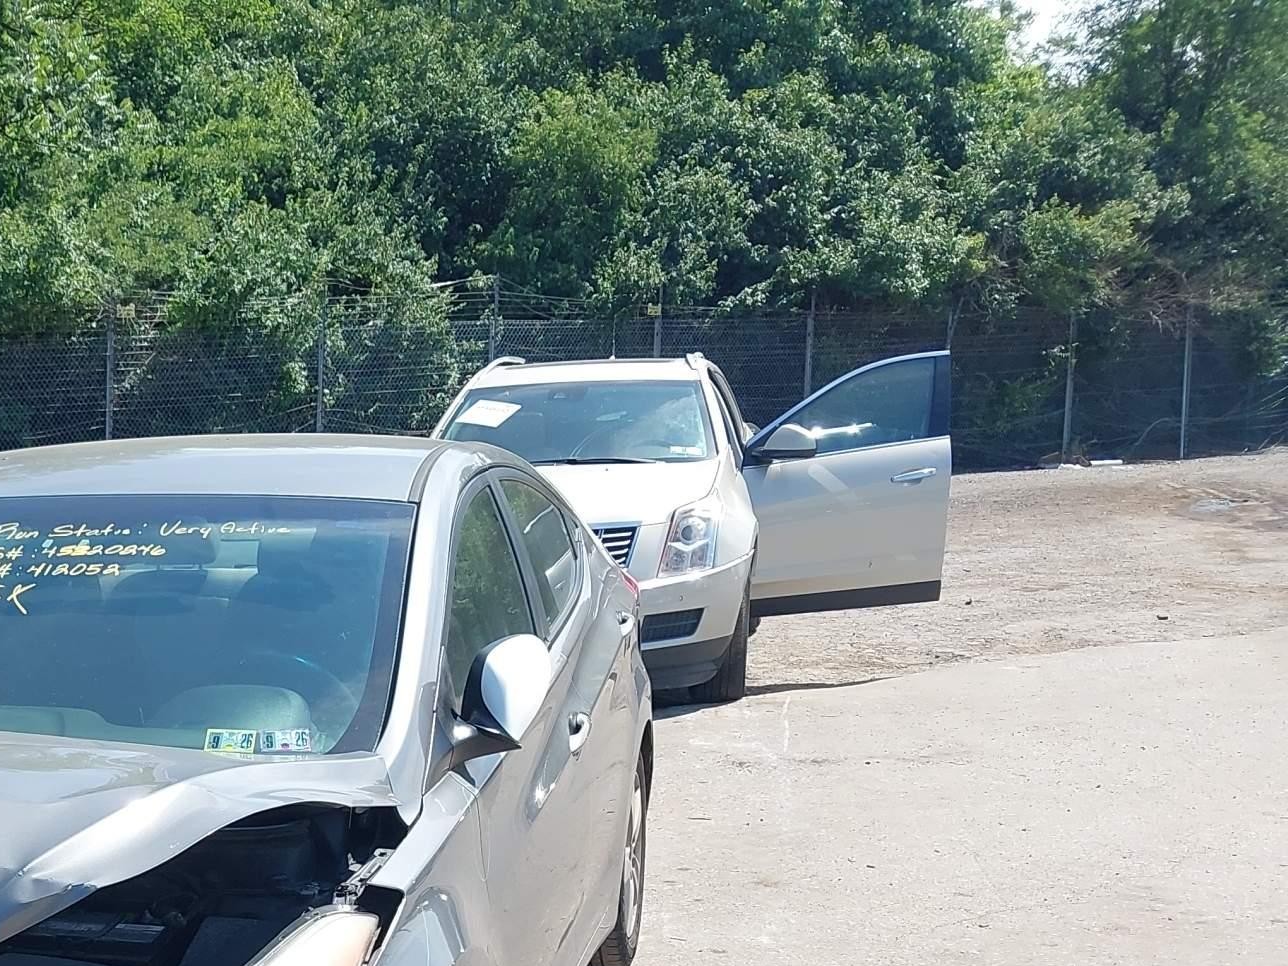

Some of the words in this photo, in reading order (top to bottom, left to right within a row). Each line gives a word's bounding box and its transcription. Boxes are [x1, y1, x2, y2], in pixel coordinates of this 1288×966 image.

[159, 520, 212, 539] Very
[220, 521, 291, 534] Active
[239, 733, 253, 749] 26
[295, 731, 308, 747] 26
